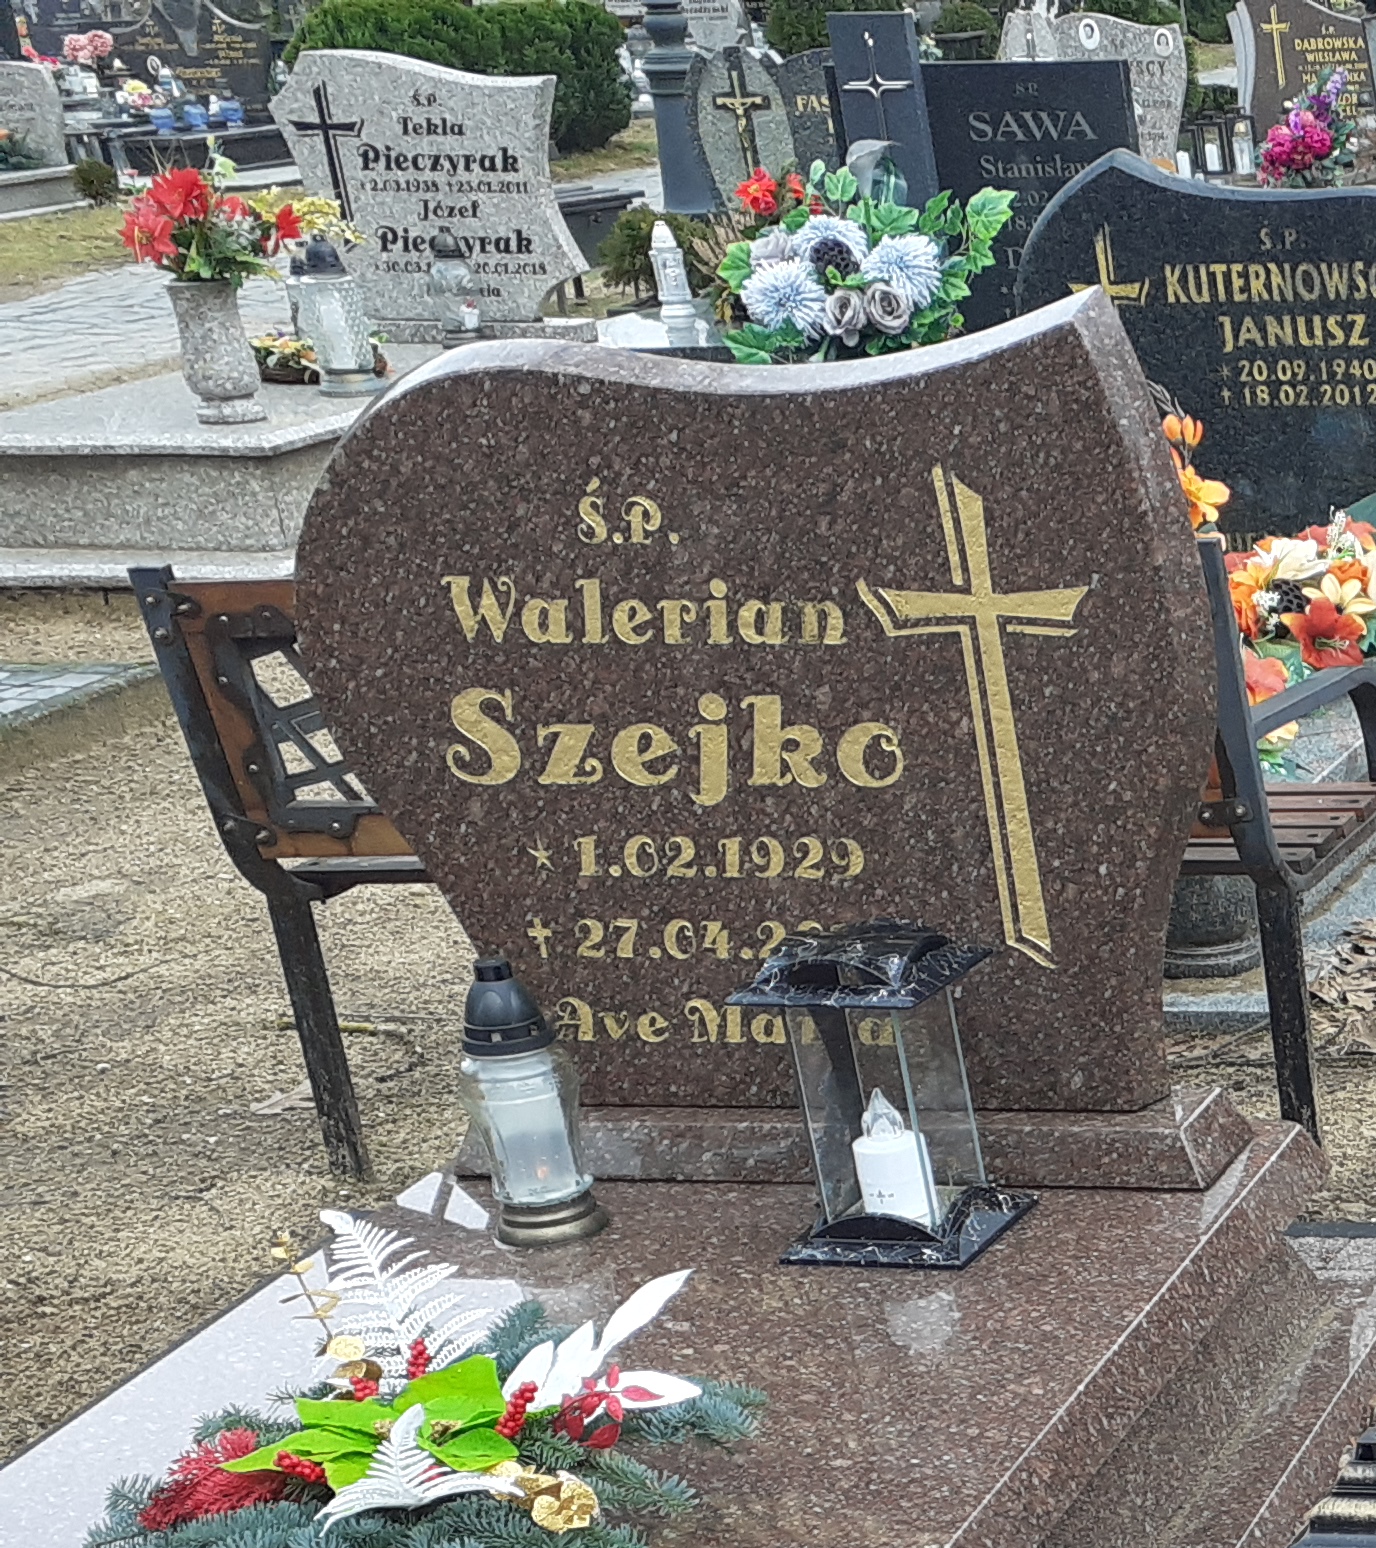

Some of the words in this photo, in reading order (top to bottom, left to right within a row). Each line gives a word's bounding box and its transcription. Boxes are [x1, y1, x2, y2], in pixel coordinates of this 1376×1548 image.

[1293, 36, 1366, 51] DĄBROWSKA
[398, 115, 466, 137] Tekla
[967, 110, 1099, 143] SAWA
[356, 142, 520, 178] Pieczyrak
[417, 198, 482, 222] Józef
[374, 224, 534, 260] Pieyrak
[1217, 313, 1371, 354] JANUSZ
[576, 475, 681, 546] Ś.P.
[440, 575, 848, 646] Walerian
[445, 686, 905, 807] Szejko
[574, 834, 866, 880] 1.02.1929
[575, 917, 845, 962] 27.04.2
[555, 996, 670, 1044] Ave
